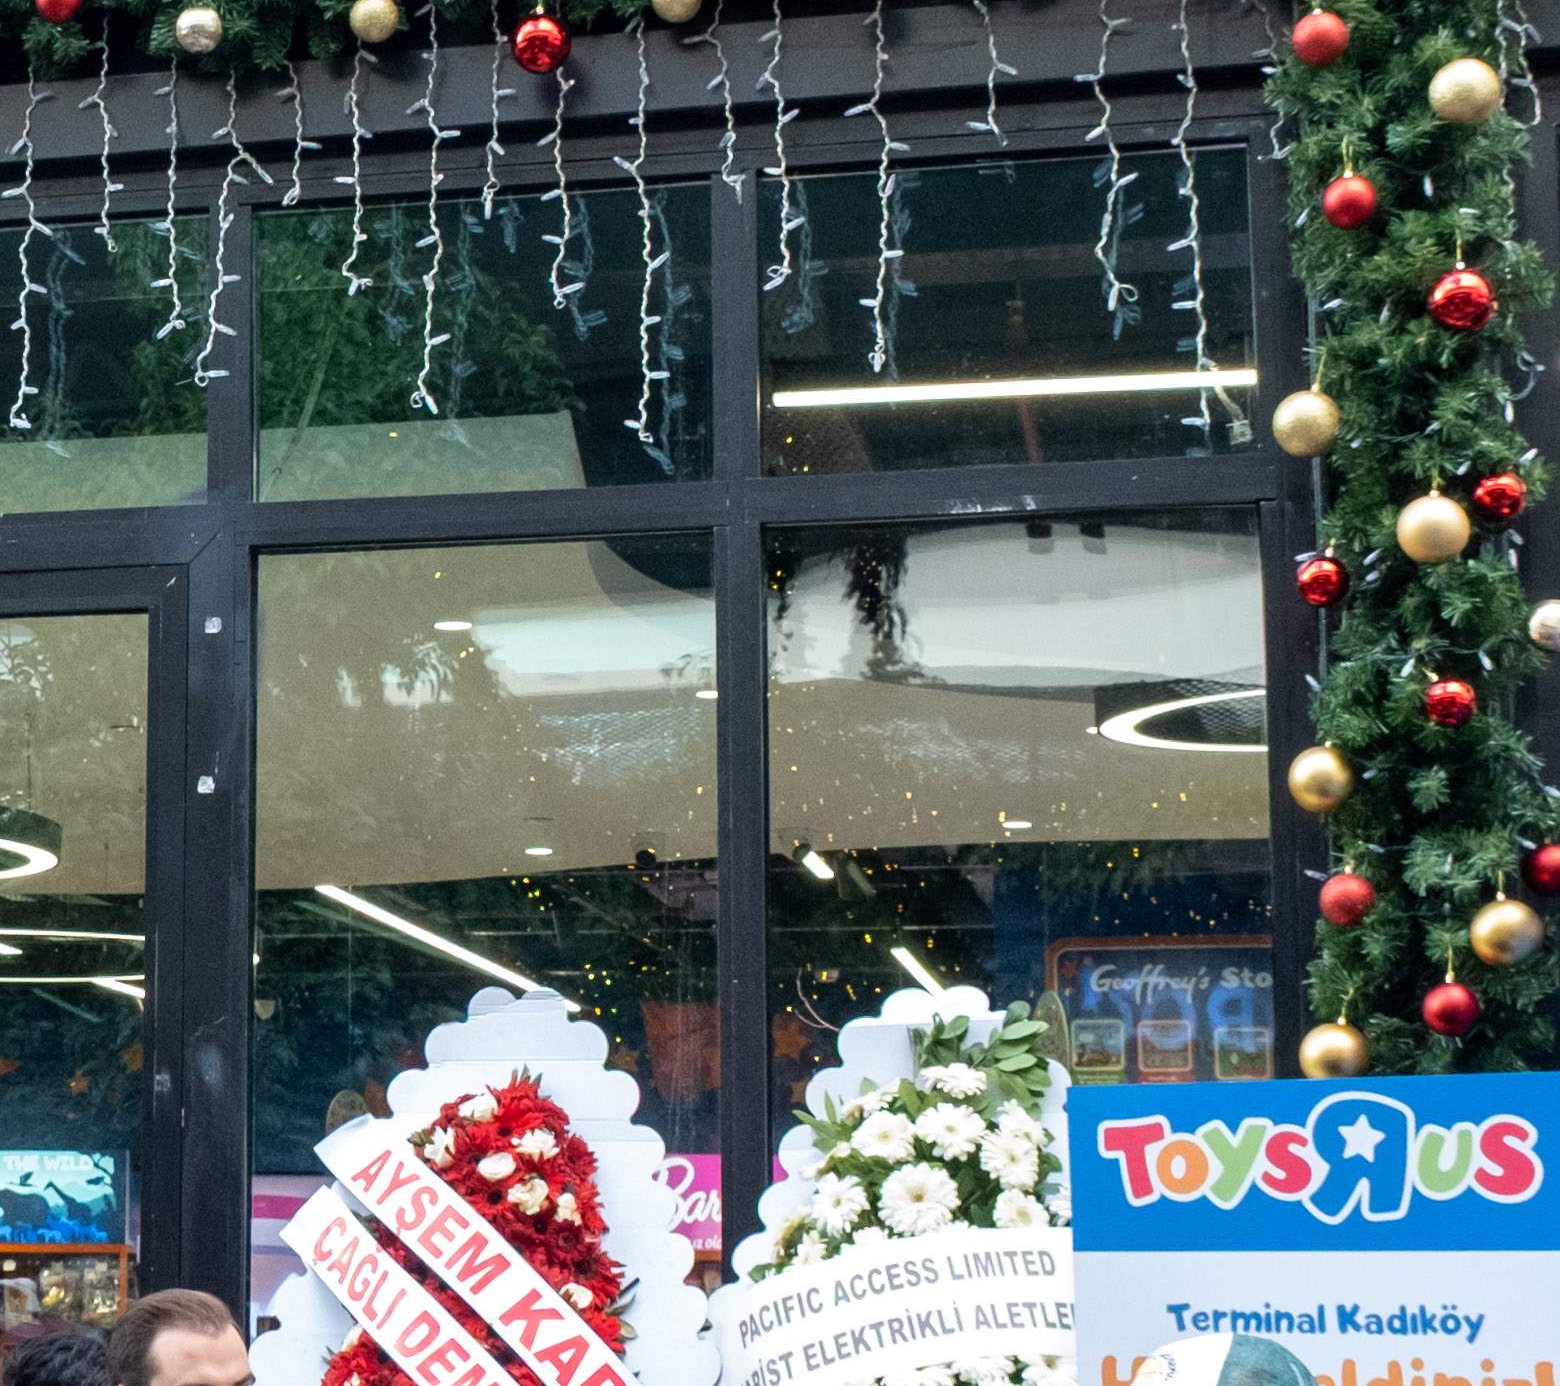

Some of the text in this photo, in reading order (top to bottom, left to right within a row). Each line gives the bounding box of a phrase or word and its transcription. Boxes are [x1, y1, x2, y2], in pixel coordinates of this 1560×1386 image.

[3, 1154, 40, 1172] THE
[43, 1154, 93, 1172] WILD
[351, 1149, 511, 1296] AYŞEM
[738, 1250, 1056, 1349] PACIFIC ACCESS LIMITED
[1166, 1302, 1485, 1343] Terminal Kadıköy
[802, 1300, 965, 1372] ELEKTRİKLİ
[975, 1302, 1075, 1331] ALETLE
